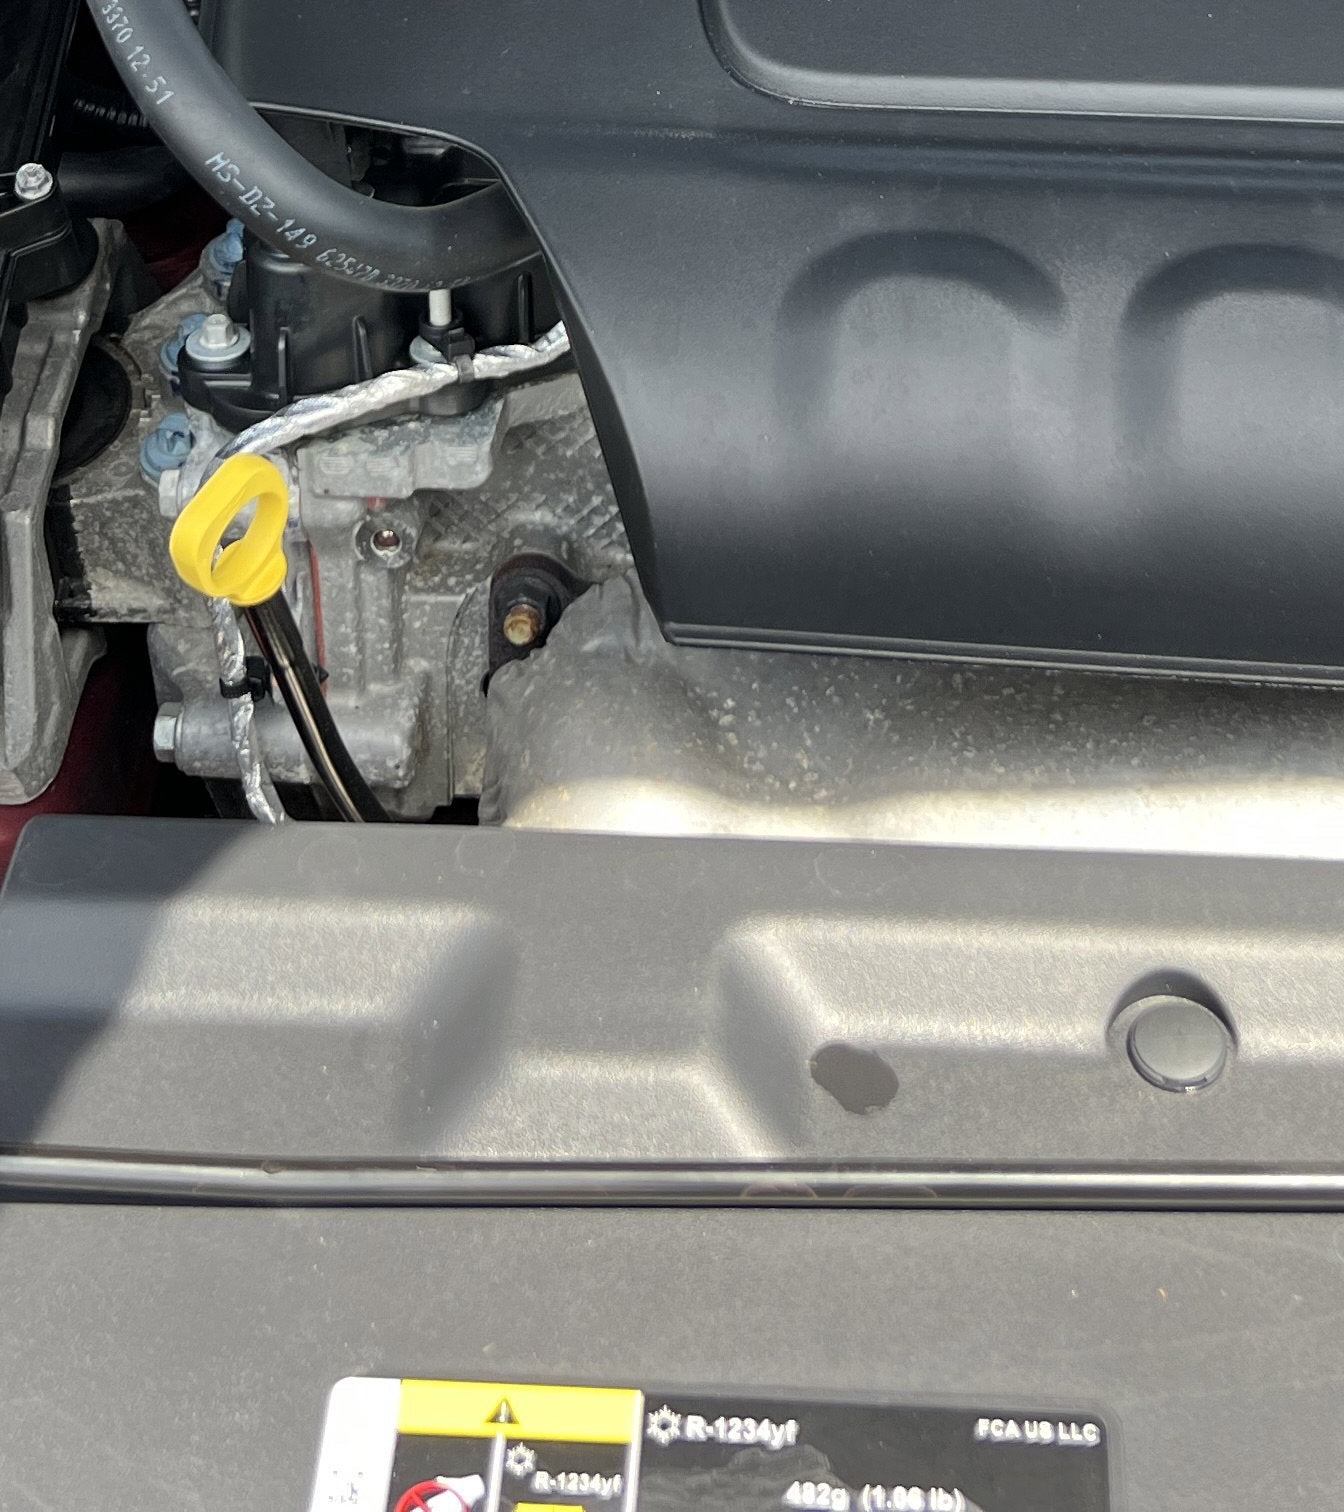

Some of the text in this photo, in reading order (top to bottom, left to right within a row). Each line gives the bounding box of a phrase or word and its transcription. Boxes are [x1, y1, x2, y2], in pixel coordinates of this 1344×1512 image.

[686, 1413, 1102, 1450] R-1234yf FCA US LLC
[532, 1470, 624, 1500] R-1234yf
